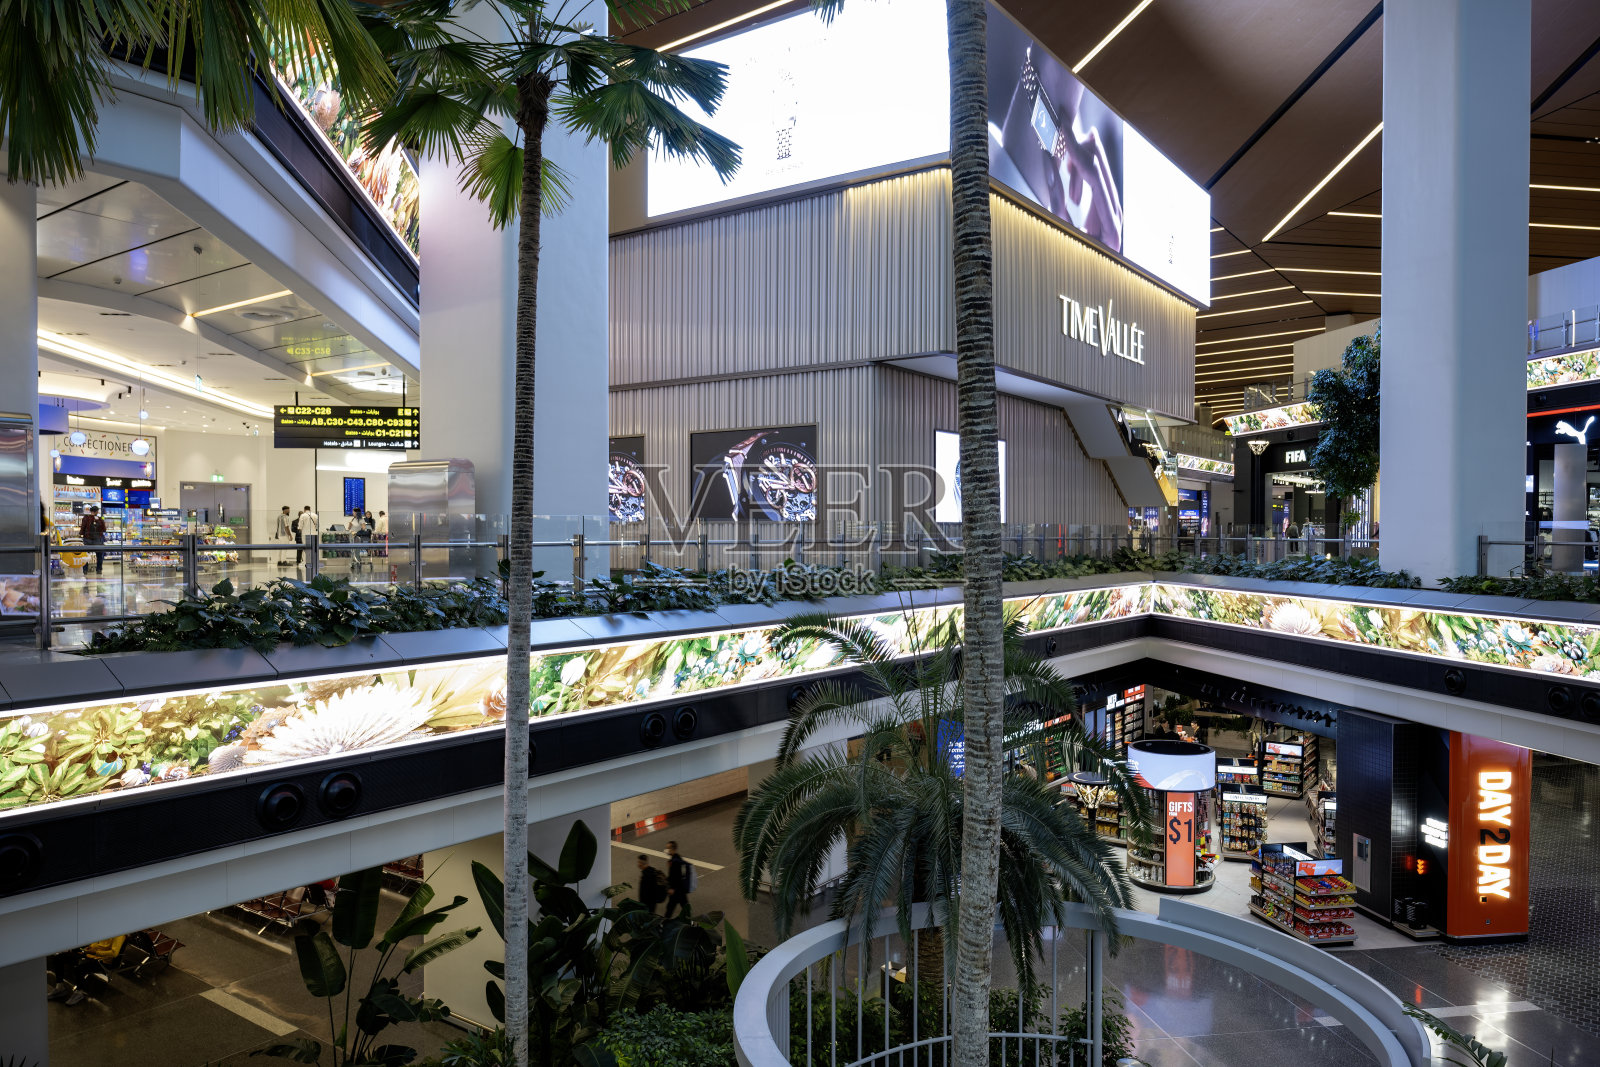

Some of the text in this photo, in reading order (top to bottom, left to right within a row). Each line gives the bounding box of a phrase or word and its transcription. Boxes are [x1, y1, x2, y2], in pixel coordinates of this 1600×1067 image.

[295, 407, 332, 415] C22-C26
[375, 429, 404, 437] C1-C21
[1285, 449, 1307, 464] FIFA
[1168, 801, 1193, 813] GIFTS
[1168, 816, 1193, 845] $1
